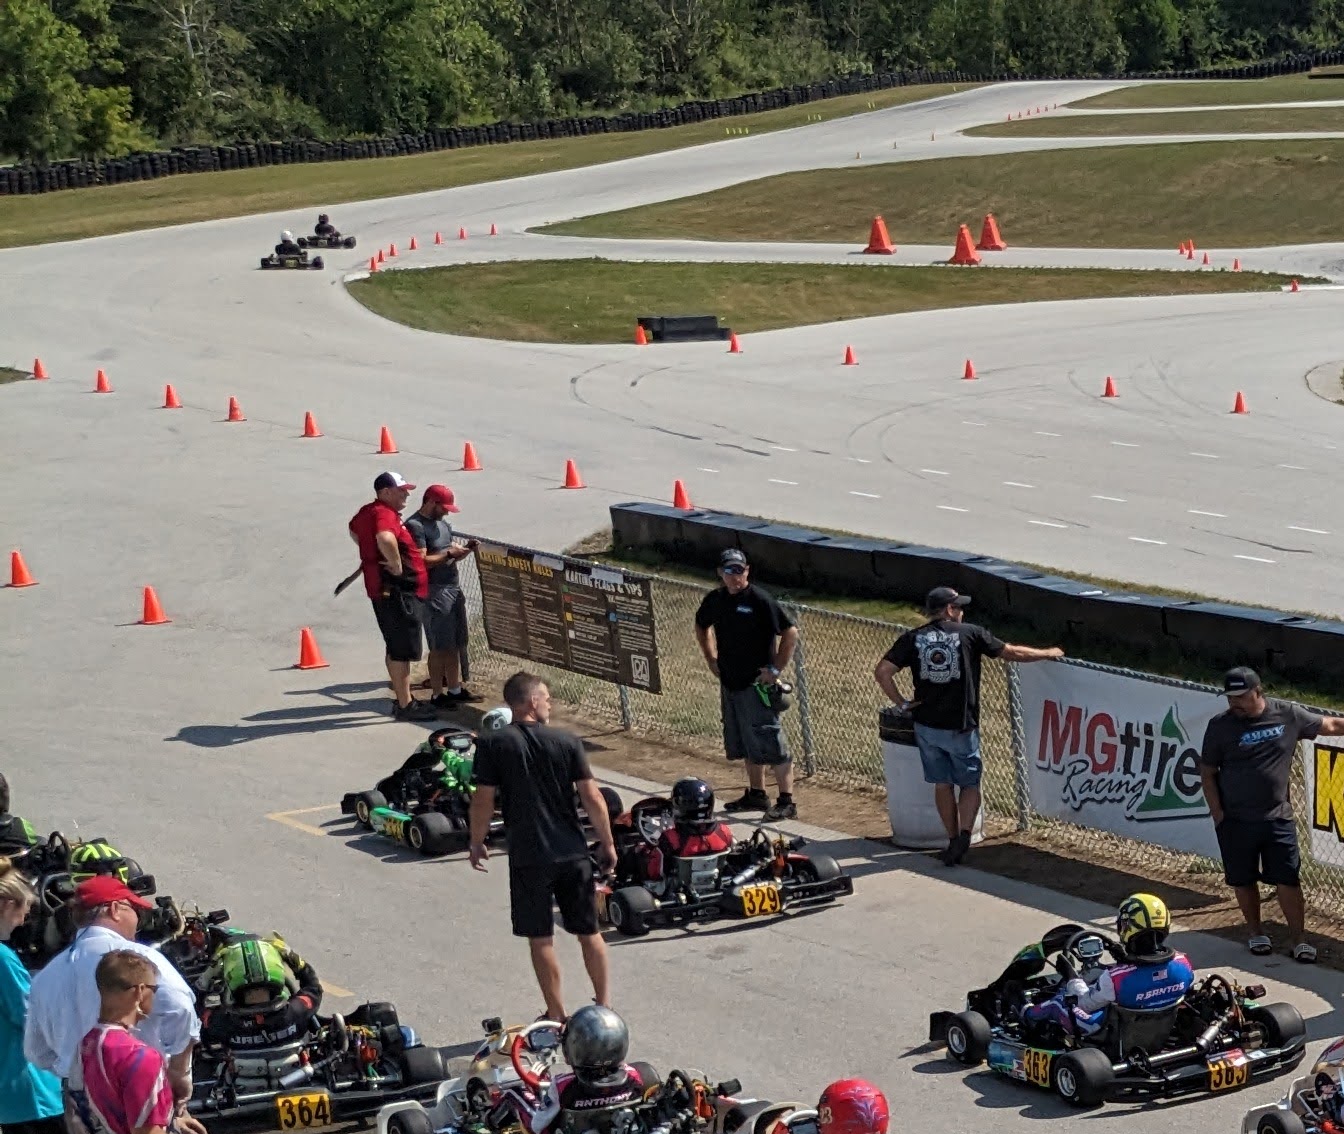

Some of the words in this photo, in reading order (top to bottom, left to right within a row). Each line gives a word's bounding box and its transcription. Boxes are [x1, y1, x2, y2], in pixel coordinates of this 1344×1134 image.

[508, 558, 532, 573] SAFETY
[625, 583, 643, 597] TIPS
[1037, 699, 1202, 796] MGtire
[1063, 759, 1148, 810] Racing
[744, 887, 779, 916] 329
[1136, 981, 1185, 1002] R.SANTOS
[1024, 1047, 1049, 1084] 363
[282, 1095, 329, 1129] 364
[574, 1091, 633, 1108] ANTHONY
